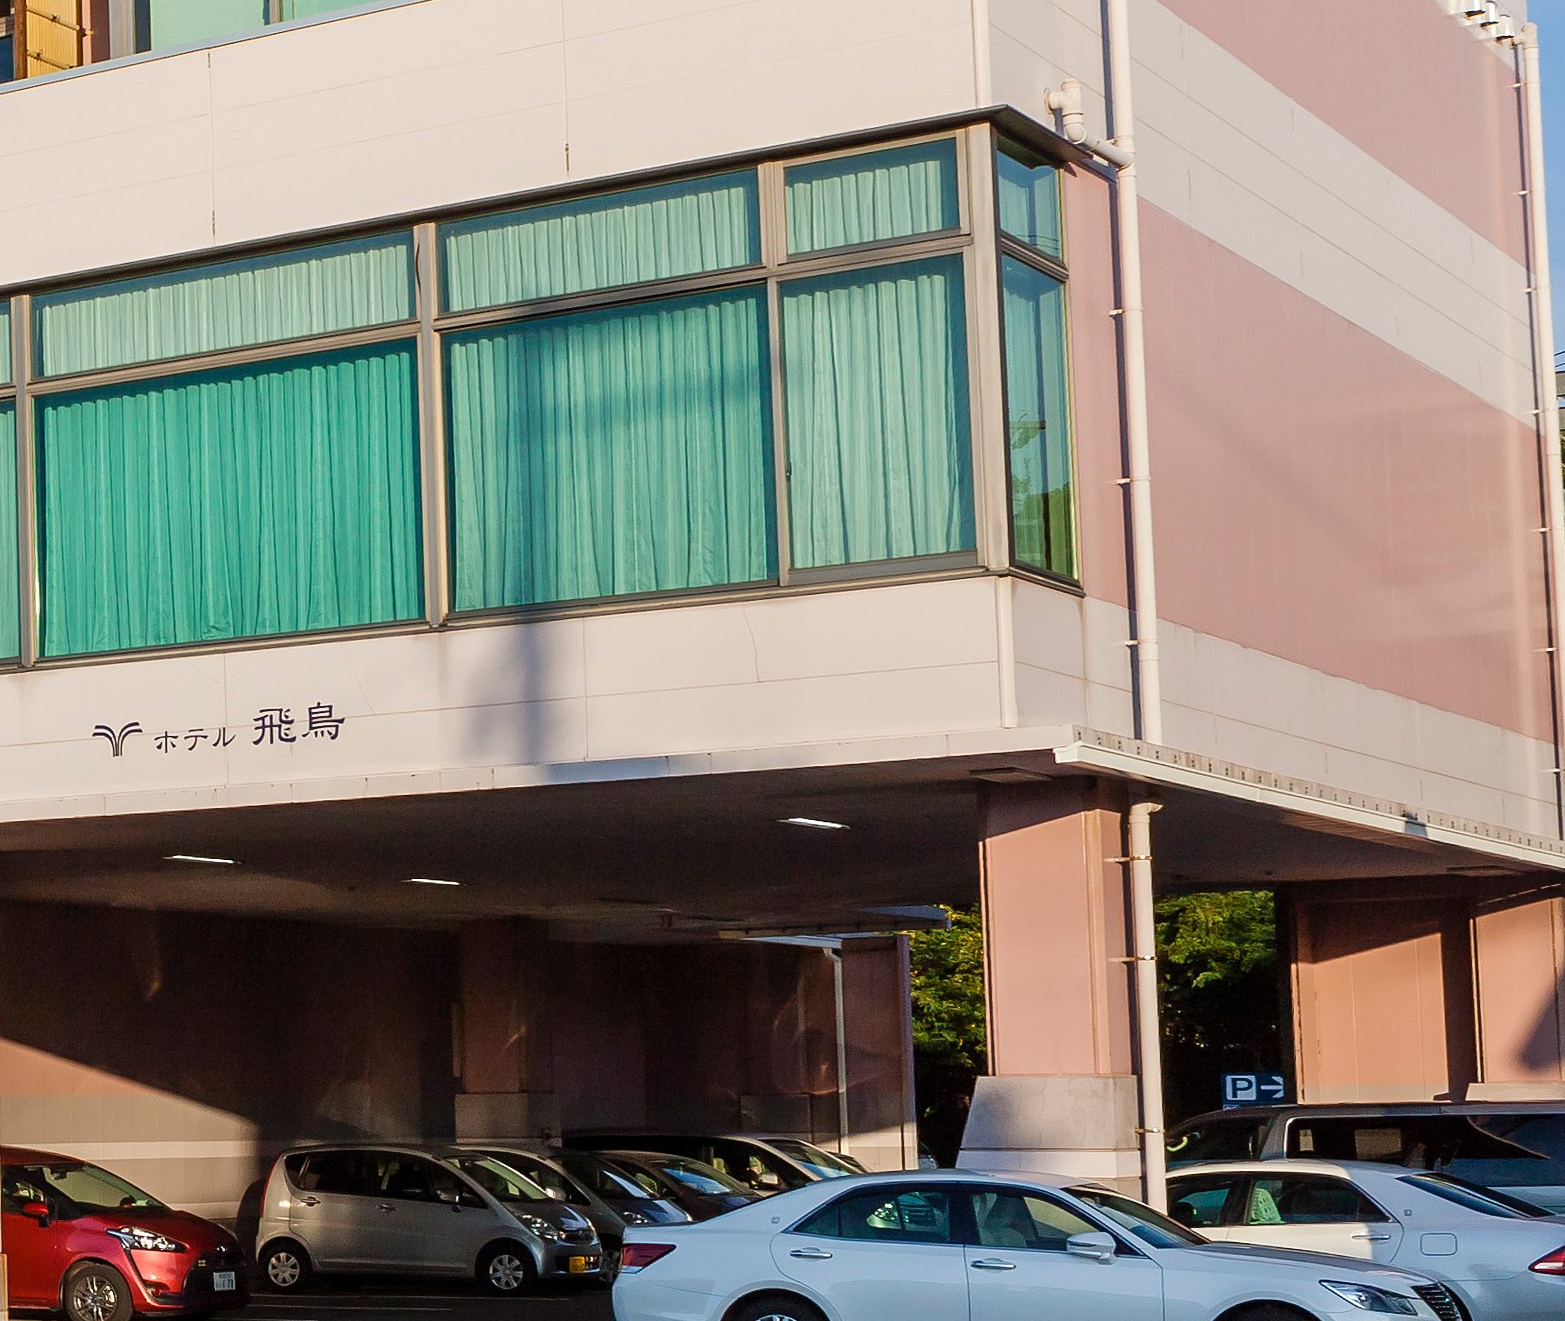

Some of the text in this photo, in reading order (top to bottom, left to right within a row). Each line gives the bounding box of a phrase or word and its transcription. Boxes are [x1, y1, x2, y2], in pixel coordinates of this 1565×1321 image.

[154, 702, 346, 753] ホテル 飛鳥
[1232, 1078, 1253, 1098] P
